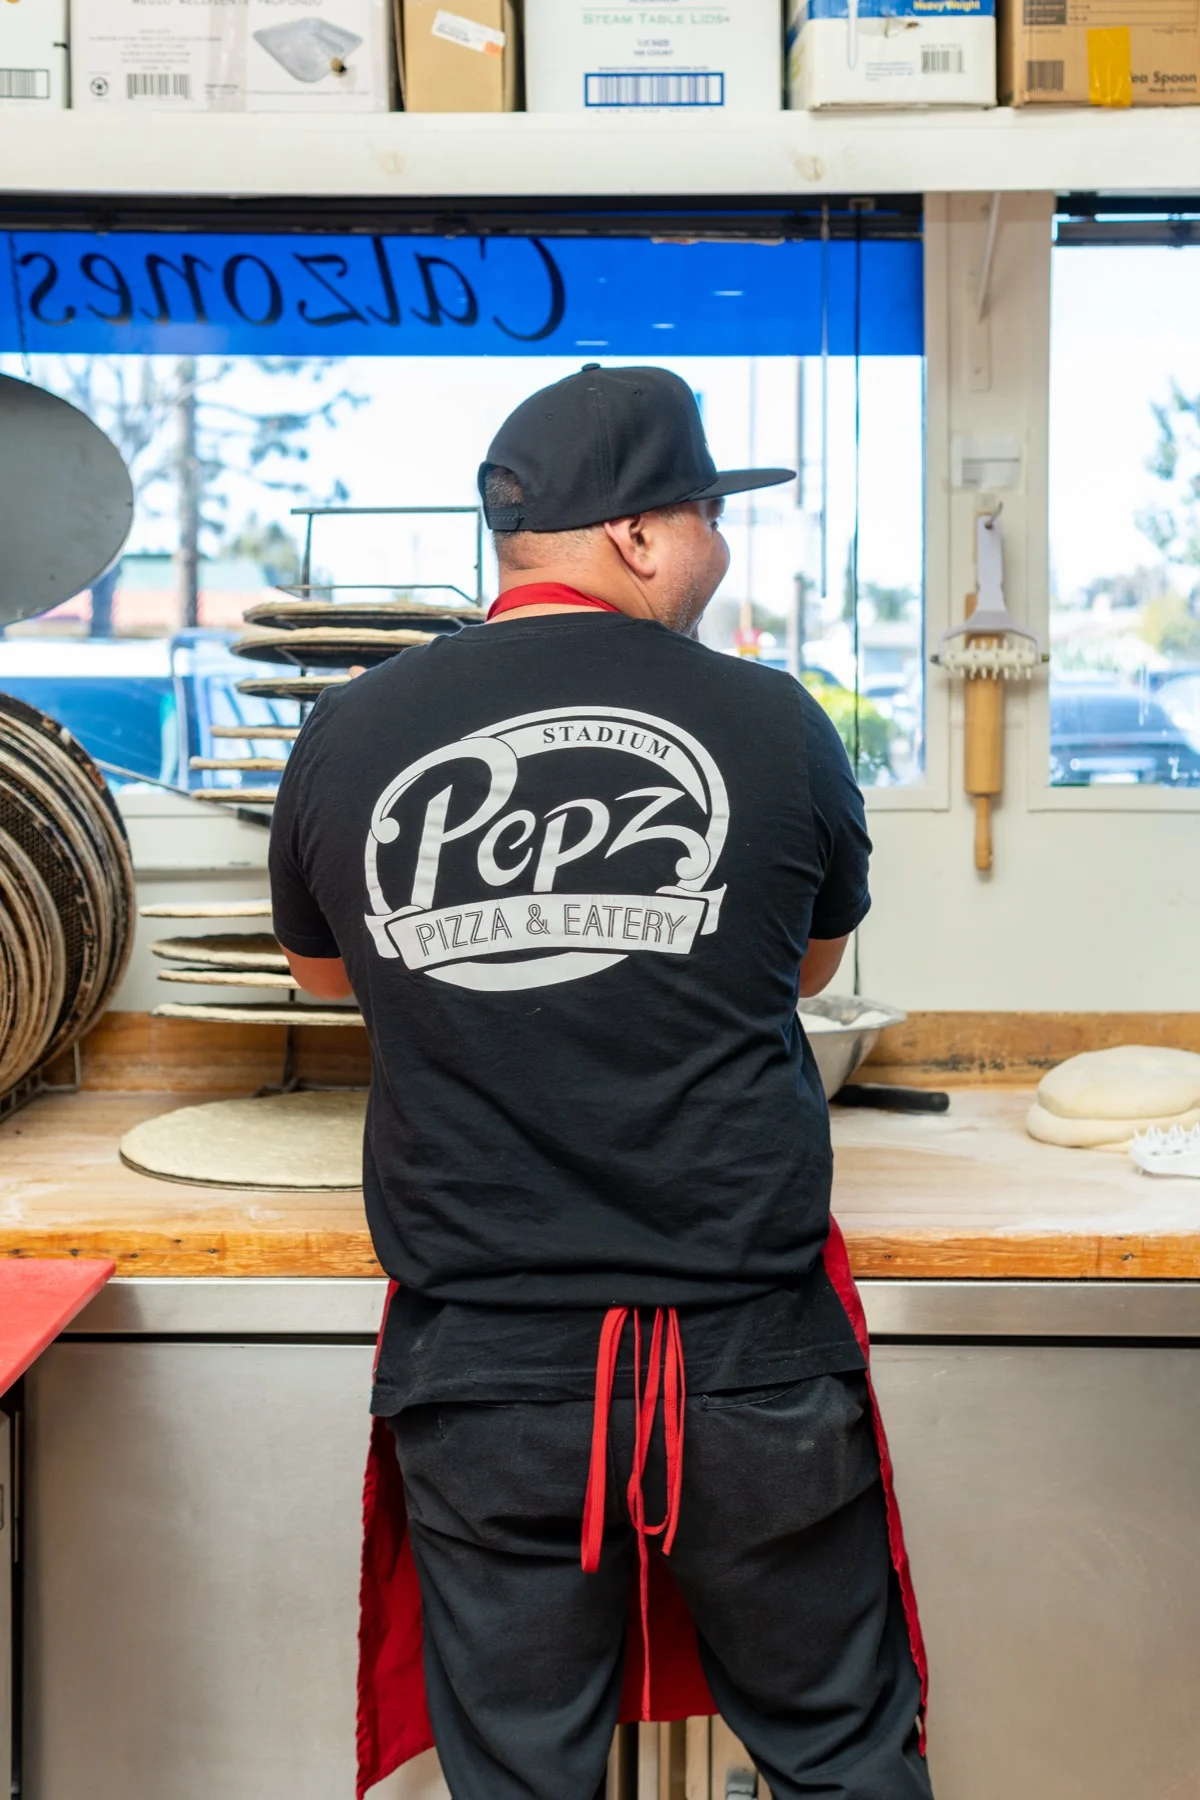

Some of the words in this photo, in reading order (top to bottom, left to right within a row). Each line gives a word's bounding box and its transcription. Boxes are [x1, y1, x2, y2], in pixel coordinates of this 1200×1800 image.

[1130, 72, 1148, 84] ea
[1153, 70, 1197, 87] Spoon
[542, 724, 673, 761] STADIUM
[371, 736, 712, 910] Pepz
[414, 907, 514, 958] PIZZA
[525, 907, 551, 936] &
[563, 903, 689, 946] EATERY
